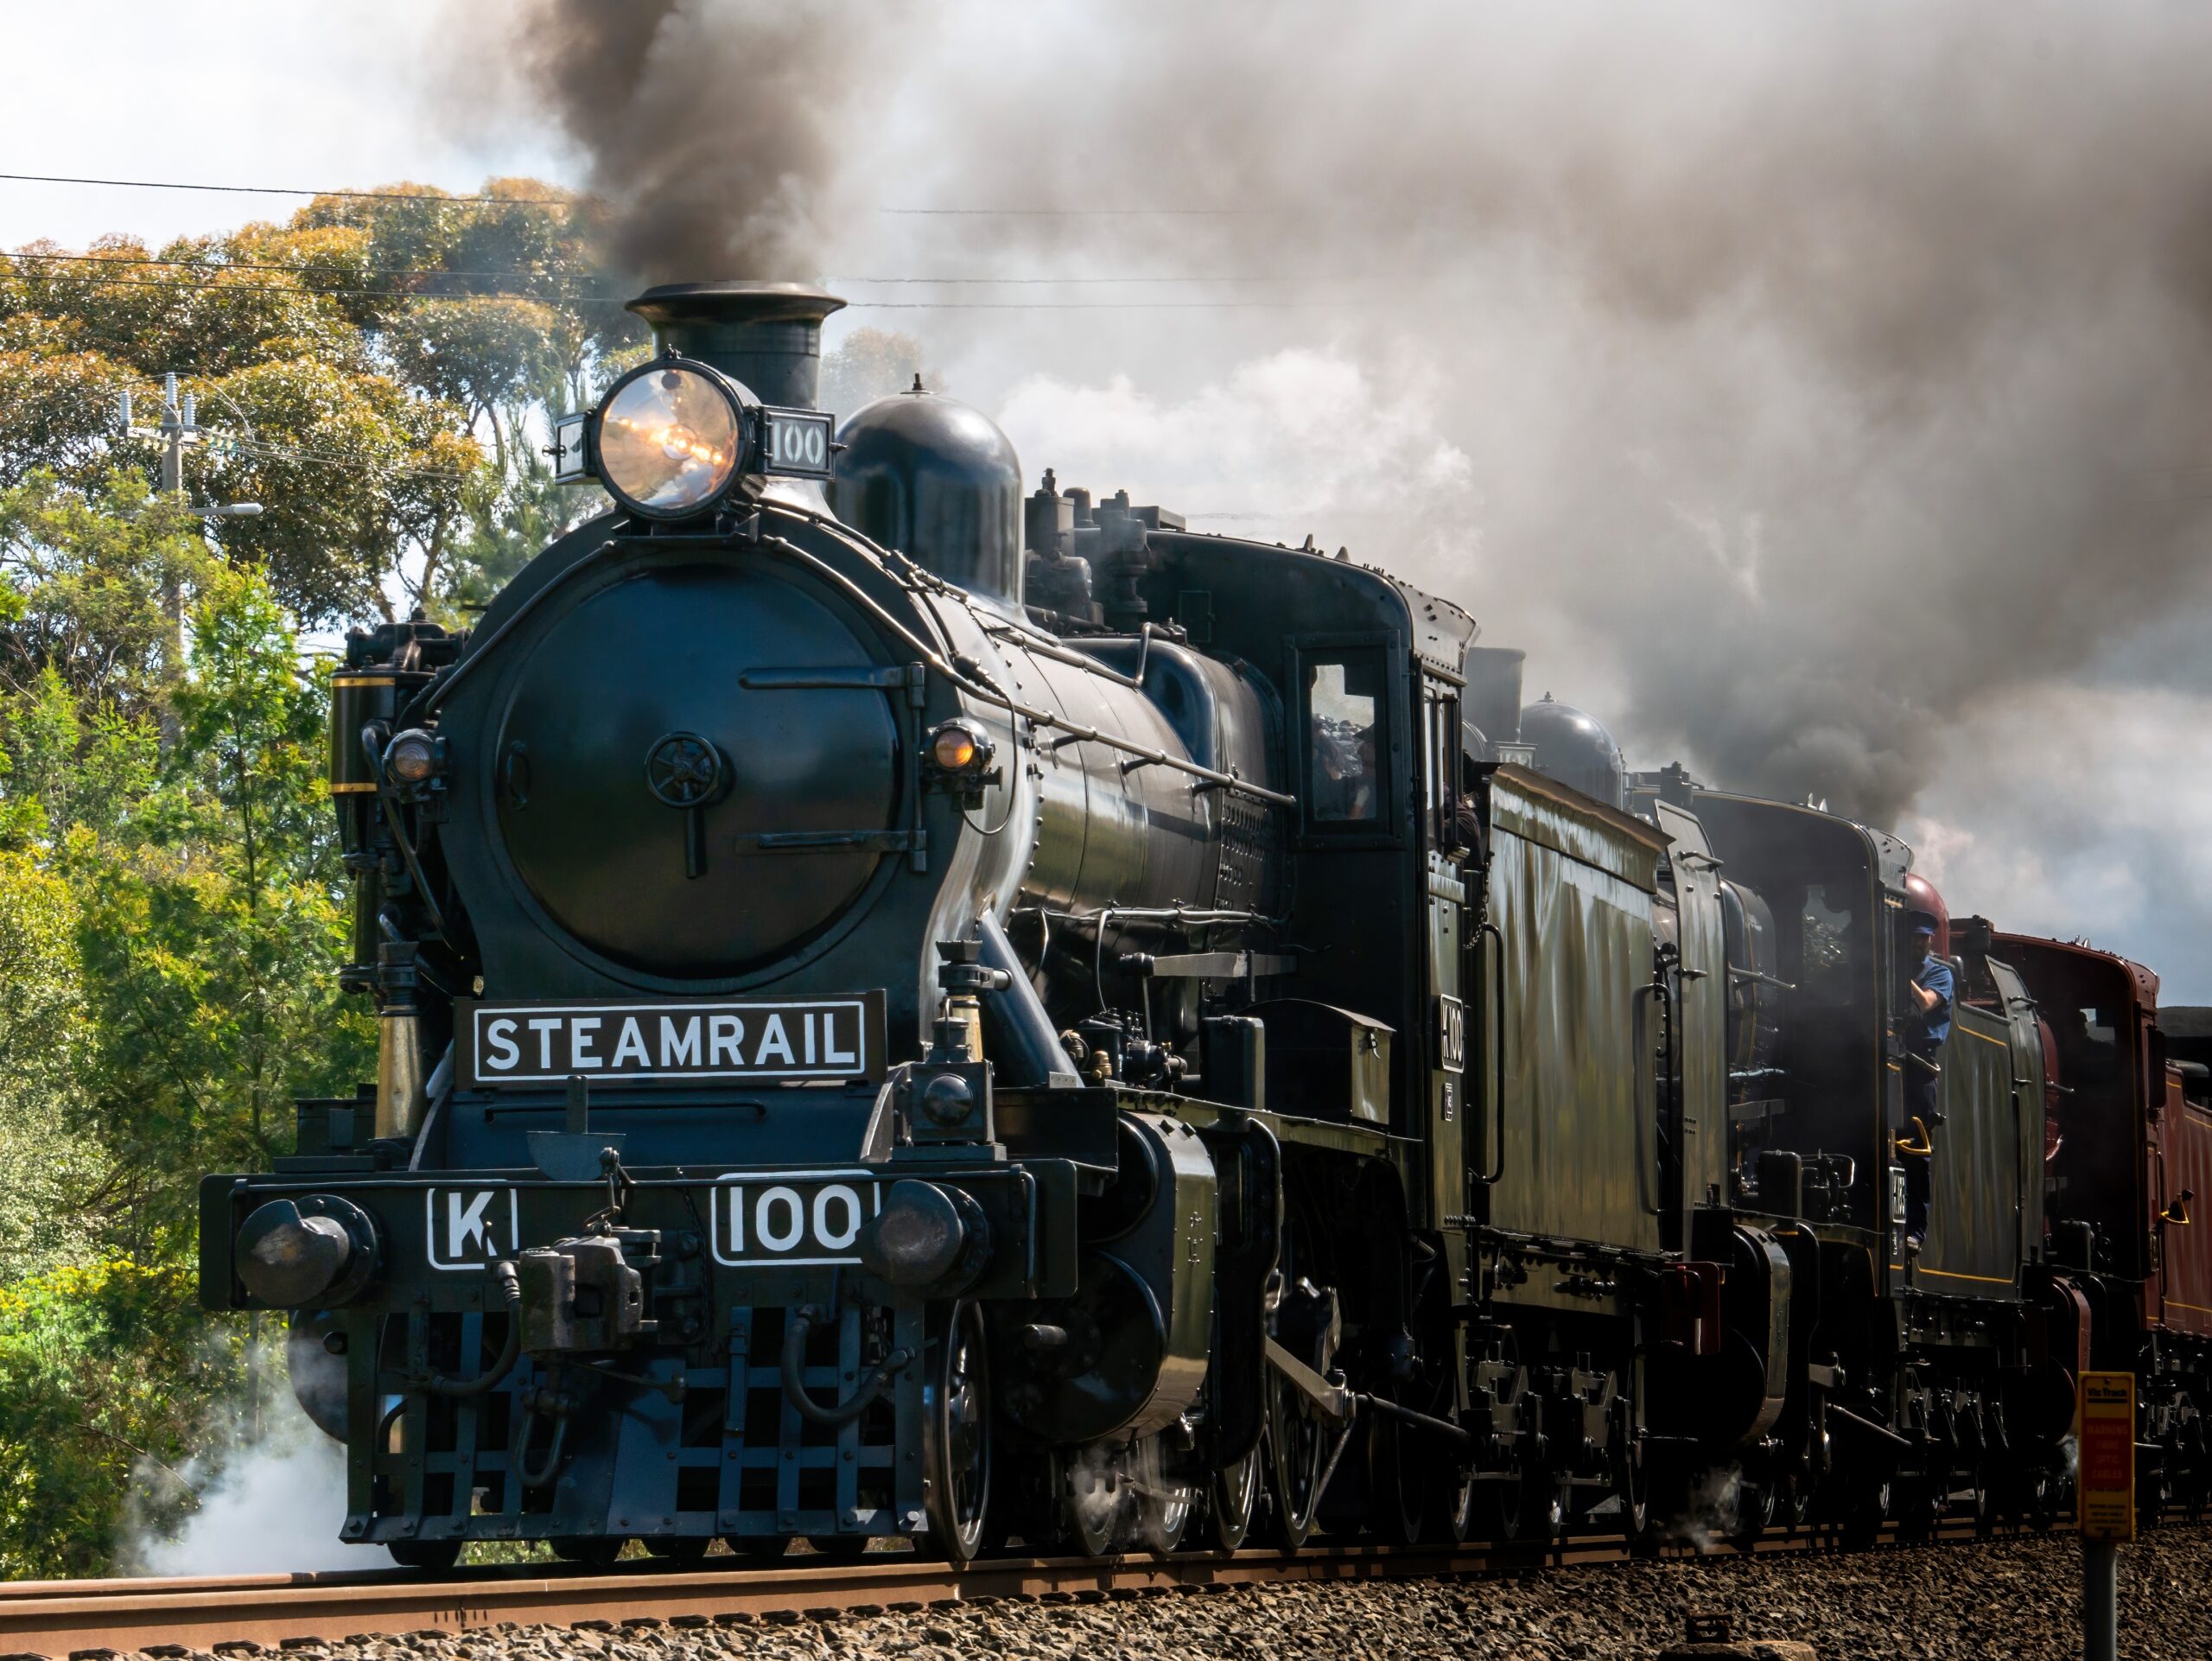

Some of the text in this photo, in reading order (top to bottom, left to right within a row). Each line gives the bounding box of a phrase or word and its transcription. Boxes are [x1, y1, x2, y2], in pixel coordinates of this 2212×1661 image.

[774, 421, 823, 465] 100
[486, 1013, 855, 1071] STEAMRAIL
[1442, 1003, 1463, 1063] K100
[448, 1184, 862, 1257] K 100
[2087, 1424, 2128, 1435] WARNING
[2094, 1454, 2120, 1464] OPTIC
